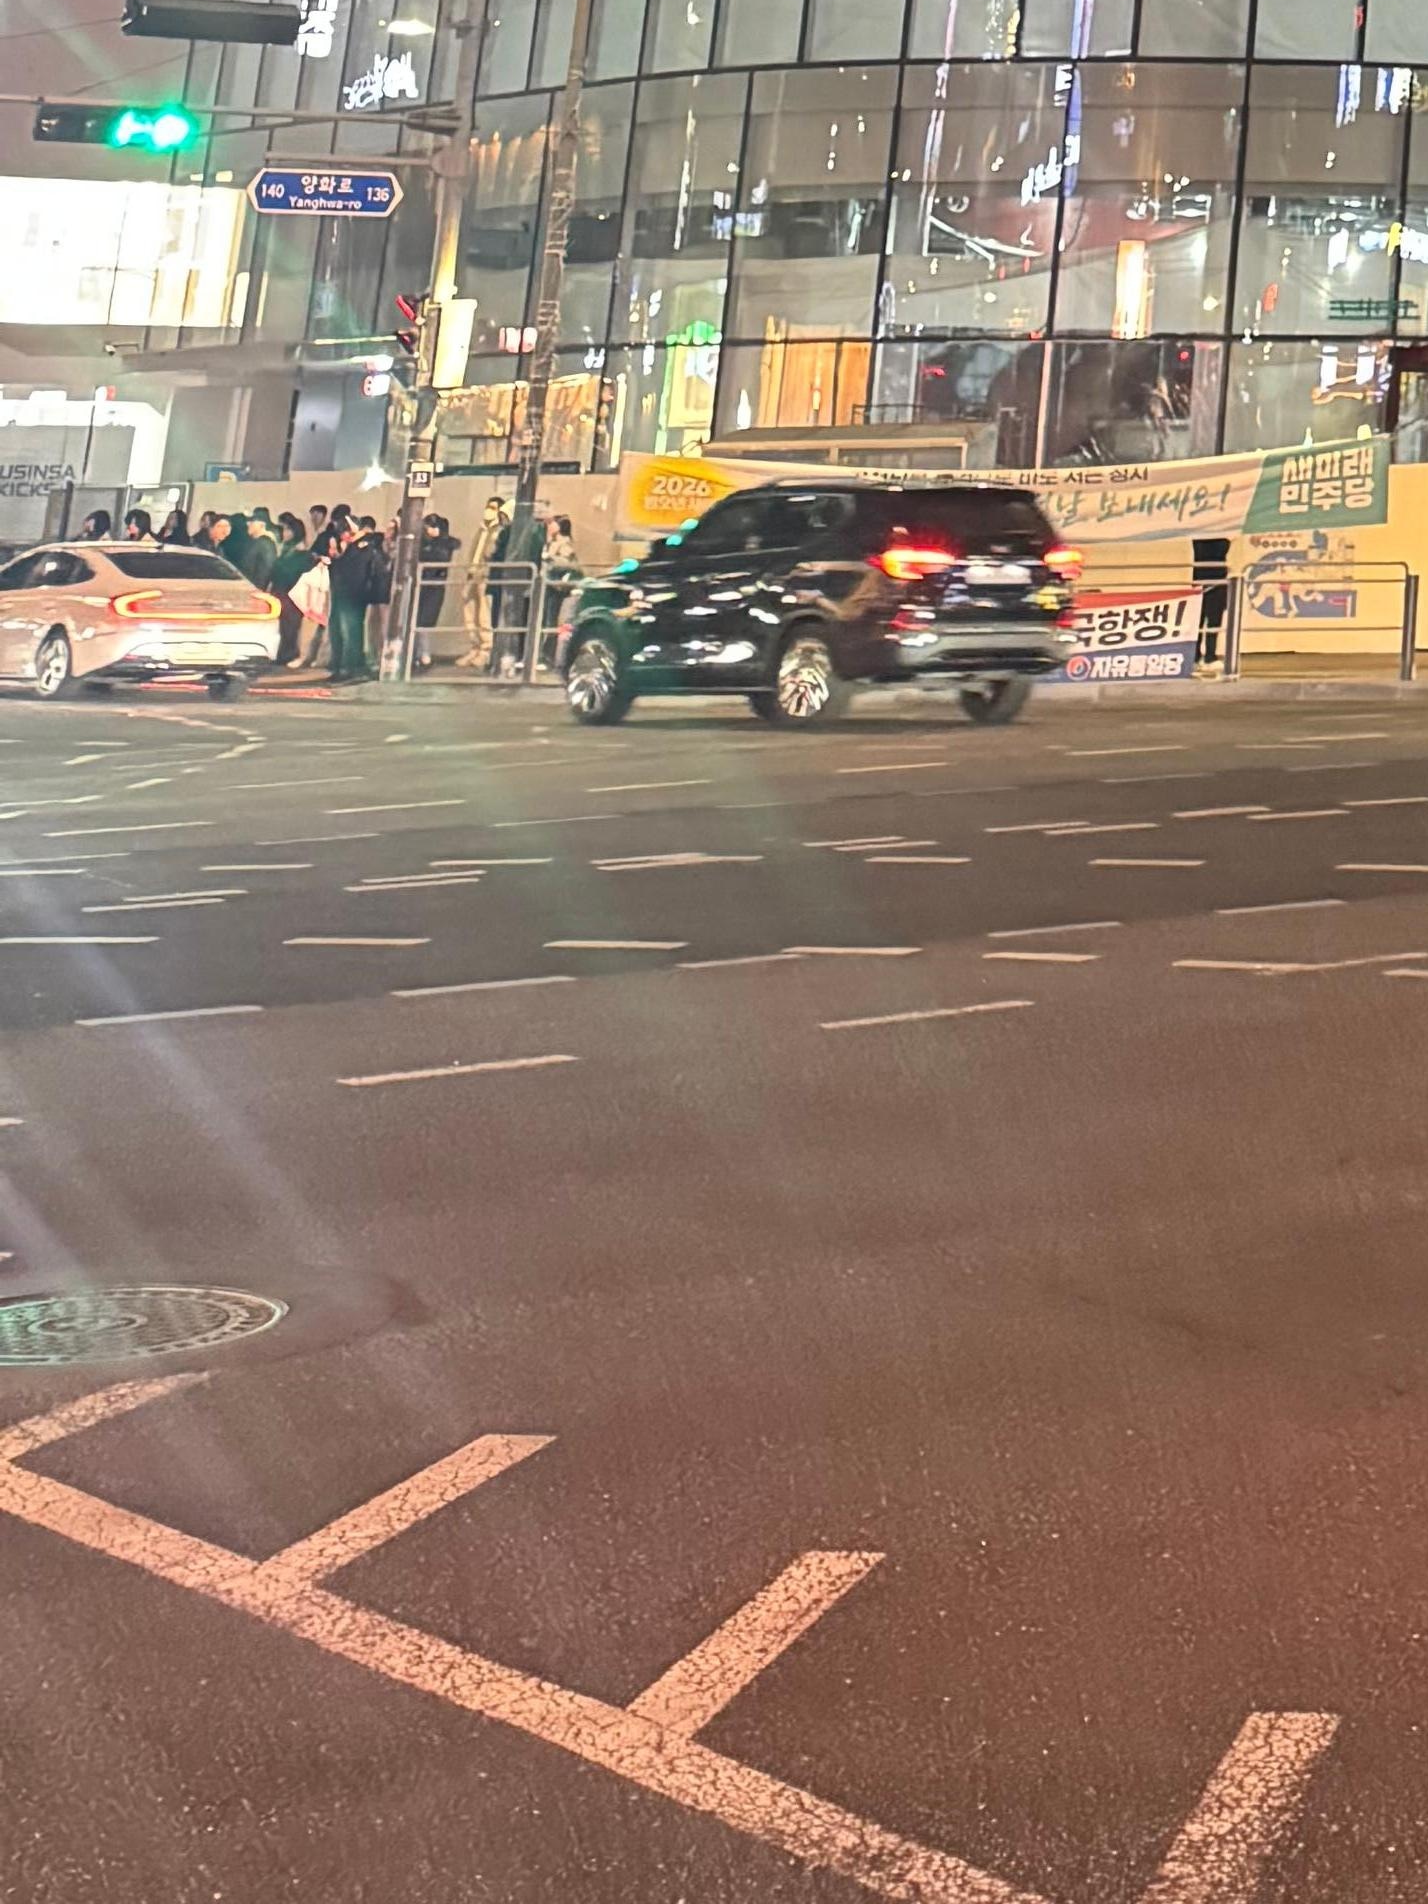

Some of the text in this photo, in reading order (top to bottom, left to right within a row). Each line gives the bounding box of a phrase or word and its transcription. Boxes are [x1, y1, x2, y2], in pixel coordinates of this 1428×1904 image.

[261, 183, 285, 198] 140
[301, 175, 354, 195] 양화로
[367, 186, 390, 202] 136
[289, 196, 362, 210] Yanghwa-ro
[1282, 447, 1374, 484] 새미래
[651, 474, 713, 497] 2026
[1278, 476, 1375, 514] 민주당
[1090, 653, 1184, 679] 자유통일당
